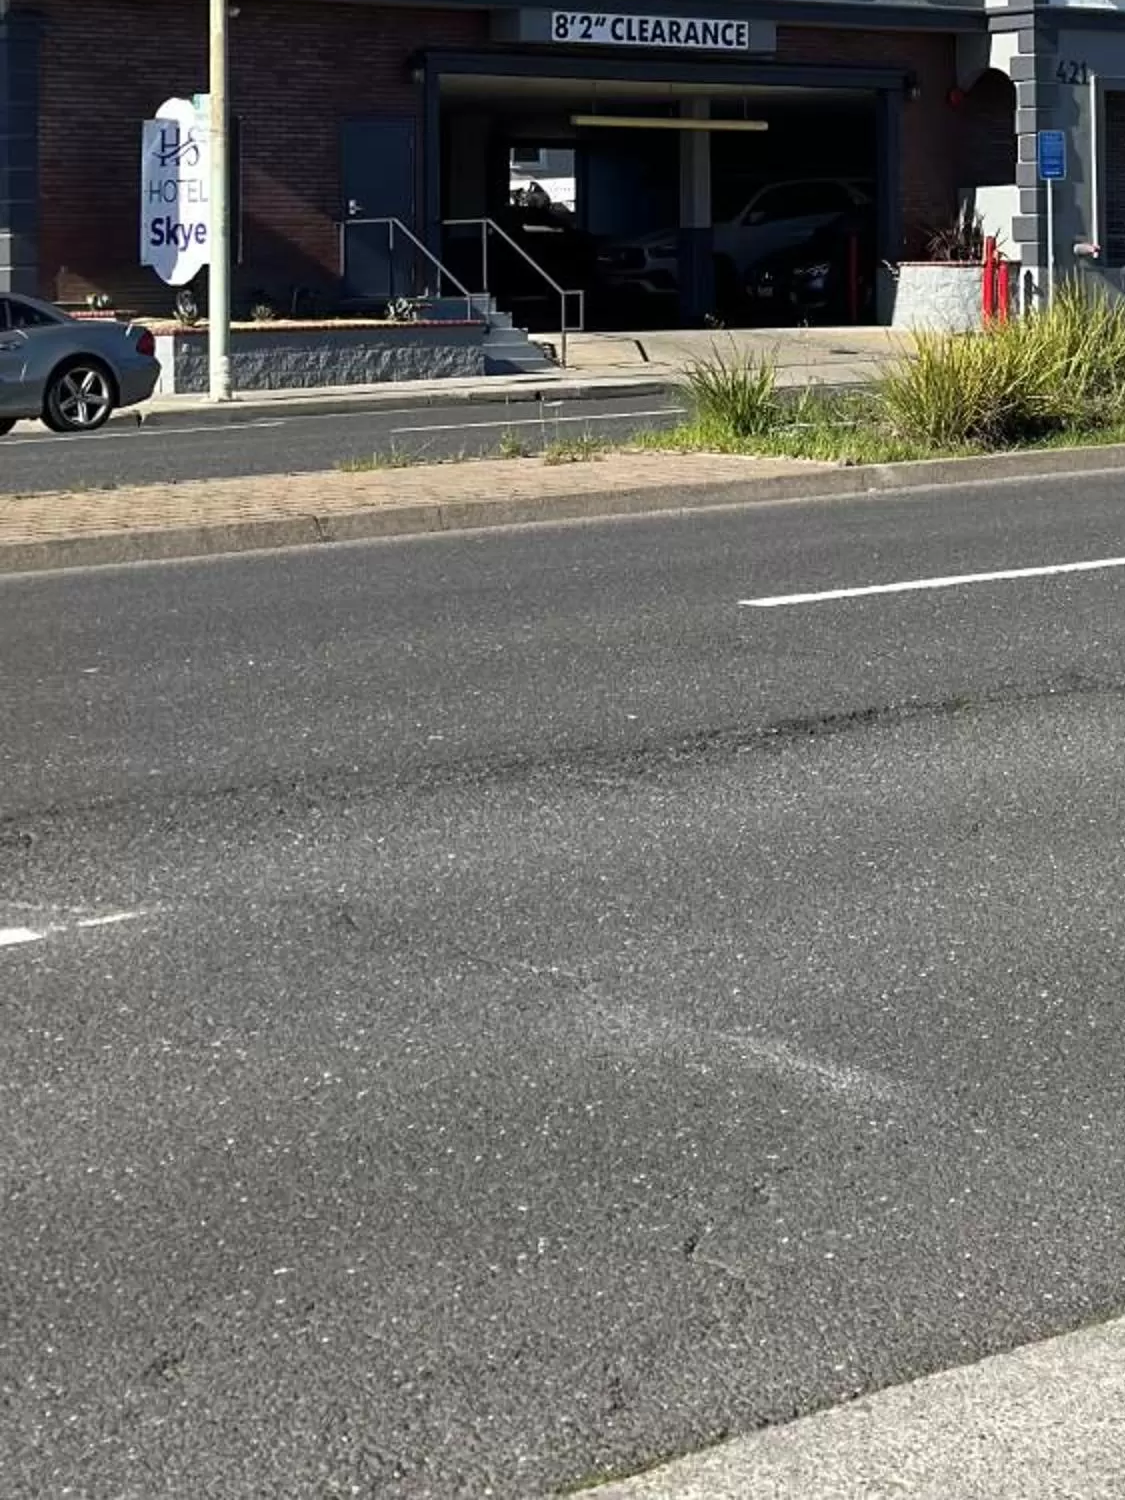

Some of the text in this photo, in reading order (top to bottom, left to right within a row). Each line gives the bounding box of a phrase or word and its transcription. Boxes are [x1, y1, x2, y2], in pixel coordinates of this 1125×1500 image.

[610, 17, 748, 47] CLEARANCE
[1056, 60, 1088, 85] 421
[149, 179, 208, 203] HOTEL
[150, 215, 207, 252] Skye
